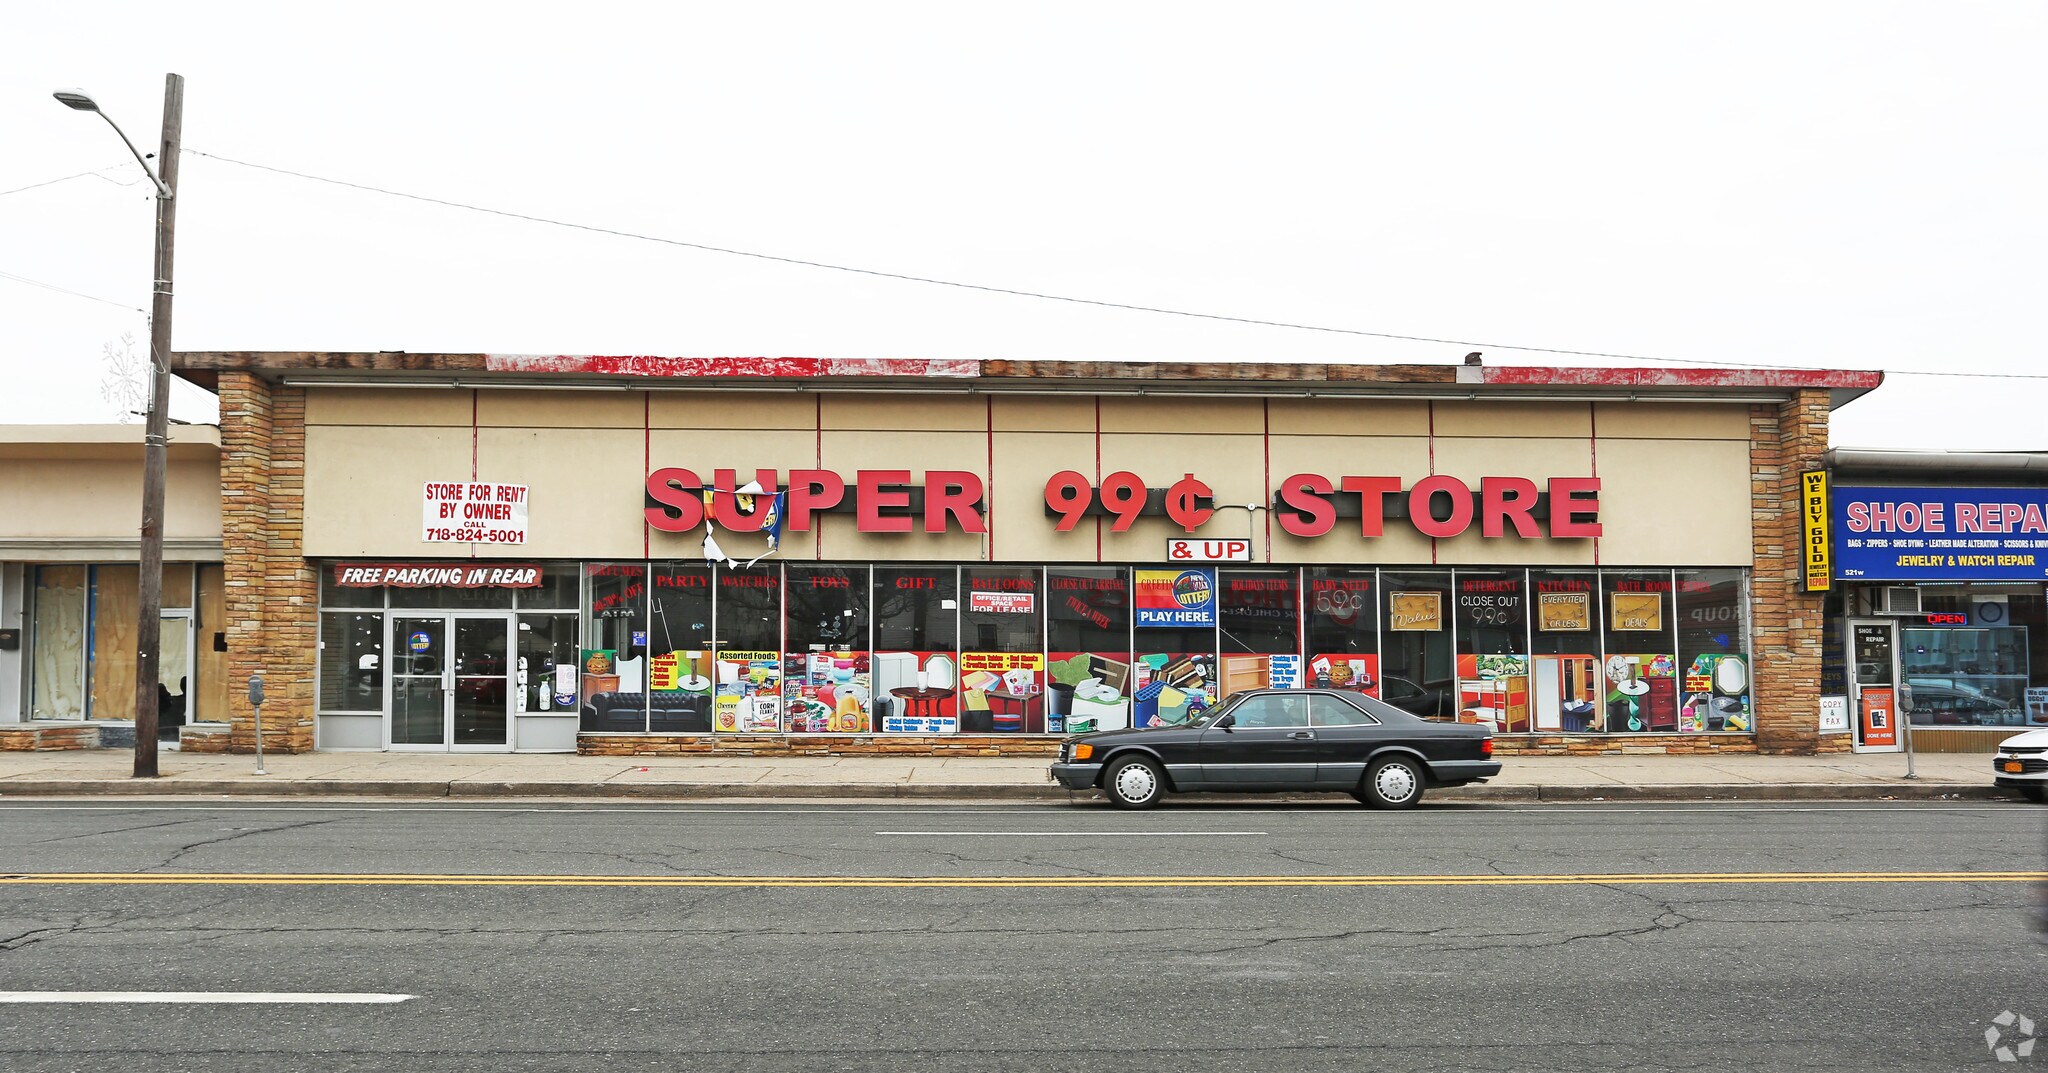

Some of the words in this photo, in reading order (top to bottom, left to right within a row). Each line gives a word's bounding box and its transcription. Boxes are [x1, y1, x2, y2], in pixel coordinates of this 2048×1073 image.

[1807, 475, 1823, 492] WE
[426, 483, 463, 500] STORE
[469, 485, 491, 501] FOR
[497, 486, 526, 502] RENT
[644, 468, 988, 533] SUPER
[1045, 470, 1214, 532] 99¢
[1278, 473, 1602, 538] STORE
[440, 503, 457, 518] BY
[464, 503, 511, 520] OWNER
[1810, 497, 1822, 523] BUY
[1847, 502, 1945, 533] SHOE
[427, 528, 524, 543] 718-824-5001
[1811, 527, 1824, 562] GOLD
[1848, 539, 1862, 548] BAGS
[1866, 539, 1888, 548] ZIPPERS
[1893, 539, 1907, 548] SHOE
[1908, 539, 1924, 548] DYING
[1929, 539, 1952, 548] LEATHER
[1953, 540, 1967, 548] MADE
[1968, 540, 1999, 548] ALTERATION
[2003, 540, 2029, 548] SCISSORS
[1171, 541, 1193, 559] &
[1204, 541, 1246, 559] UP
[1896, 556, 1944, 567] JEWELRY
[1947, 556, 1955, 567] &
[1957, 556, 1995, 566] WATCH
[1997, 556, 2035, 566] REPAIR
[341, 568, 382, 583] FREE
[383, 568, 462, 583] PARKING
[466, 569, 488, 584] IN
[489, 568, 536, 584] REAR
[656, 575, 710, 587] PARTY
[721, 576, 778, 588] WATCHES
[809, 577, 850, 588] TOYS
[896, 577, 938, 589] GIFT
[971, 577, 1034, 590] BALLOONS
[1313, 580, 1337, 591] BABY
[1343, 580, 1369, 591] NEED
[1464, 581, 1517, 592] DETERGENT
[1538, 581, 1591, 592] KITCHEN
[1617, 581, 1641, 592] BATH
[1645, 581, 1672, 592] ROOM
[1177, 589, 1210, 604] LOTTERY
[1460, 596, 1494, 606] CLOSE
[1498, 596, 1519, 606] OUT
[601, 608, 635, 617] ATM
[1141, 611, 1173, 622] PLAY
[1175, 611, 1213, 622] HERE.
[1396, 612, 1437, 627] Value
[1562, 620, 1581, 628] LESS
[1927, 614, 1965, 624] OPEN
[719, 652, 753, 660] Assorted
[754, 652, 776, 660] Foods
